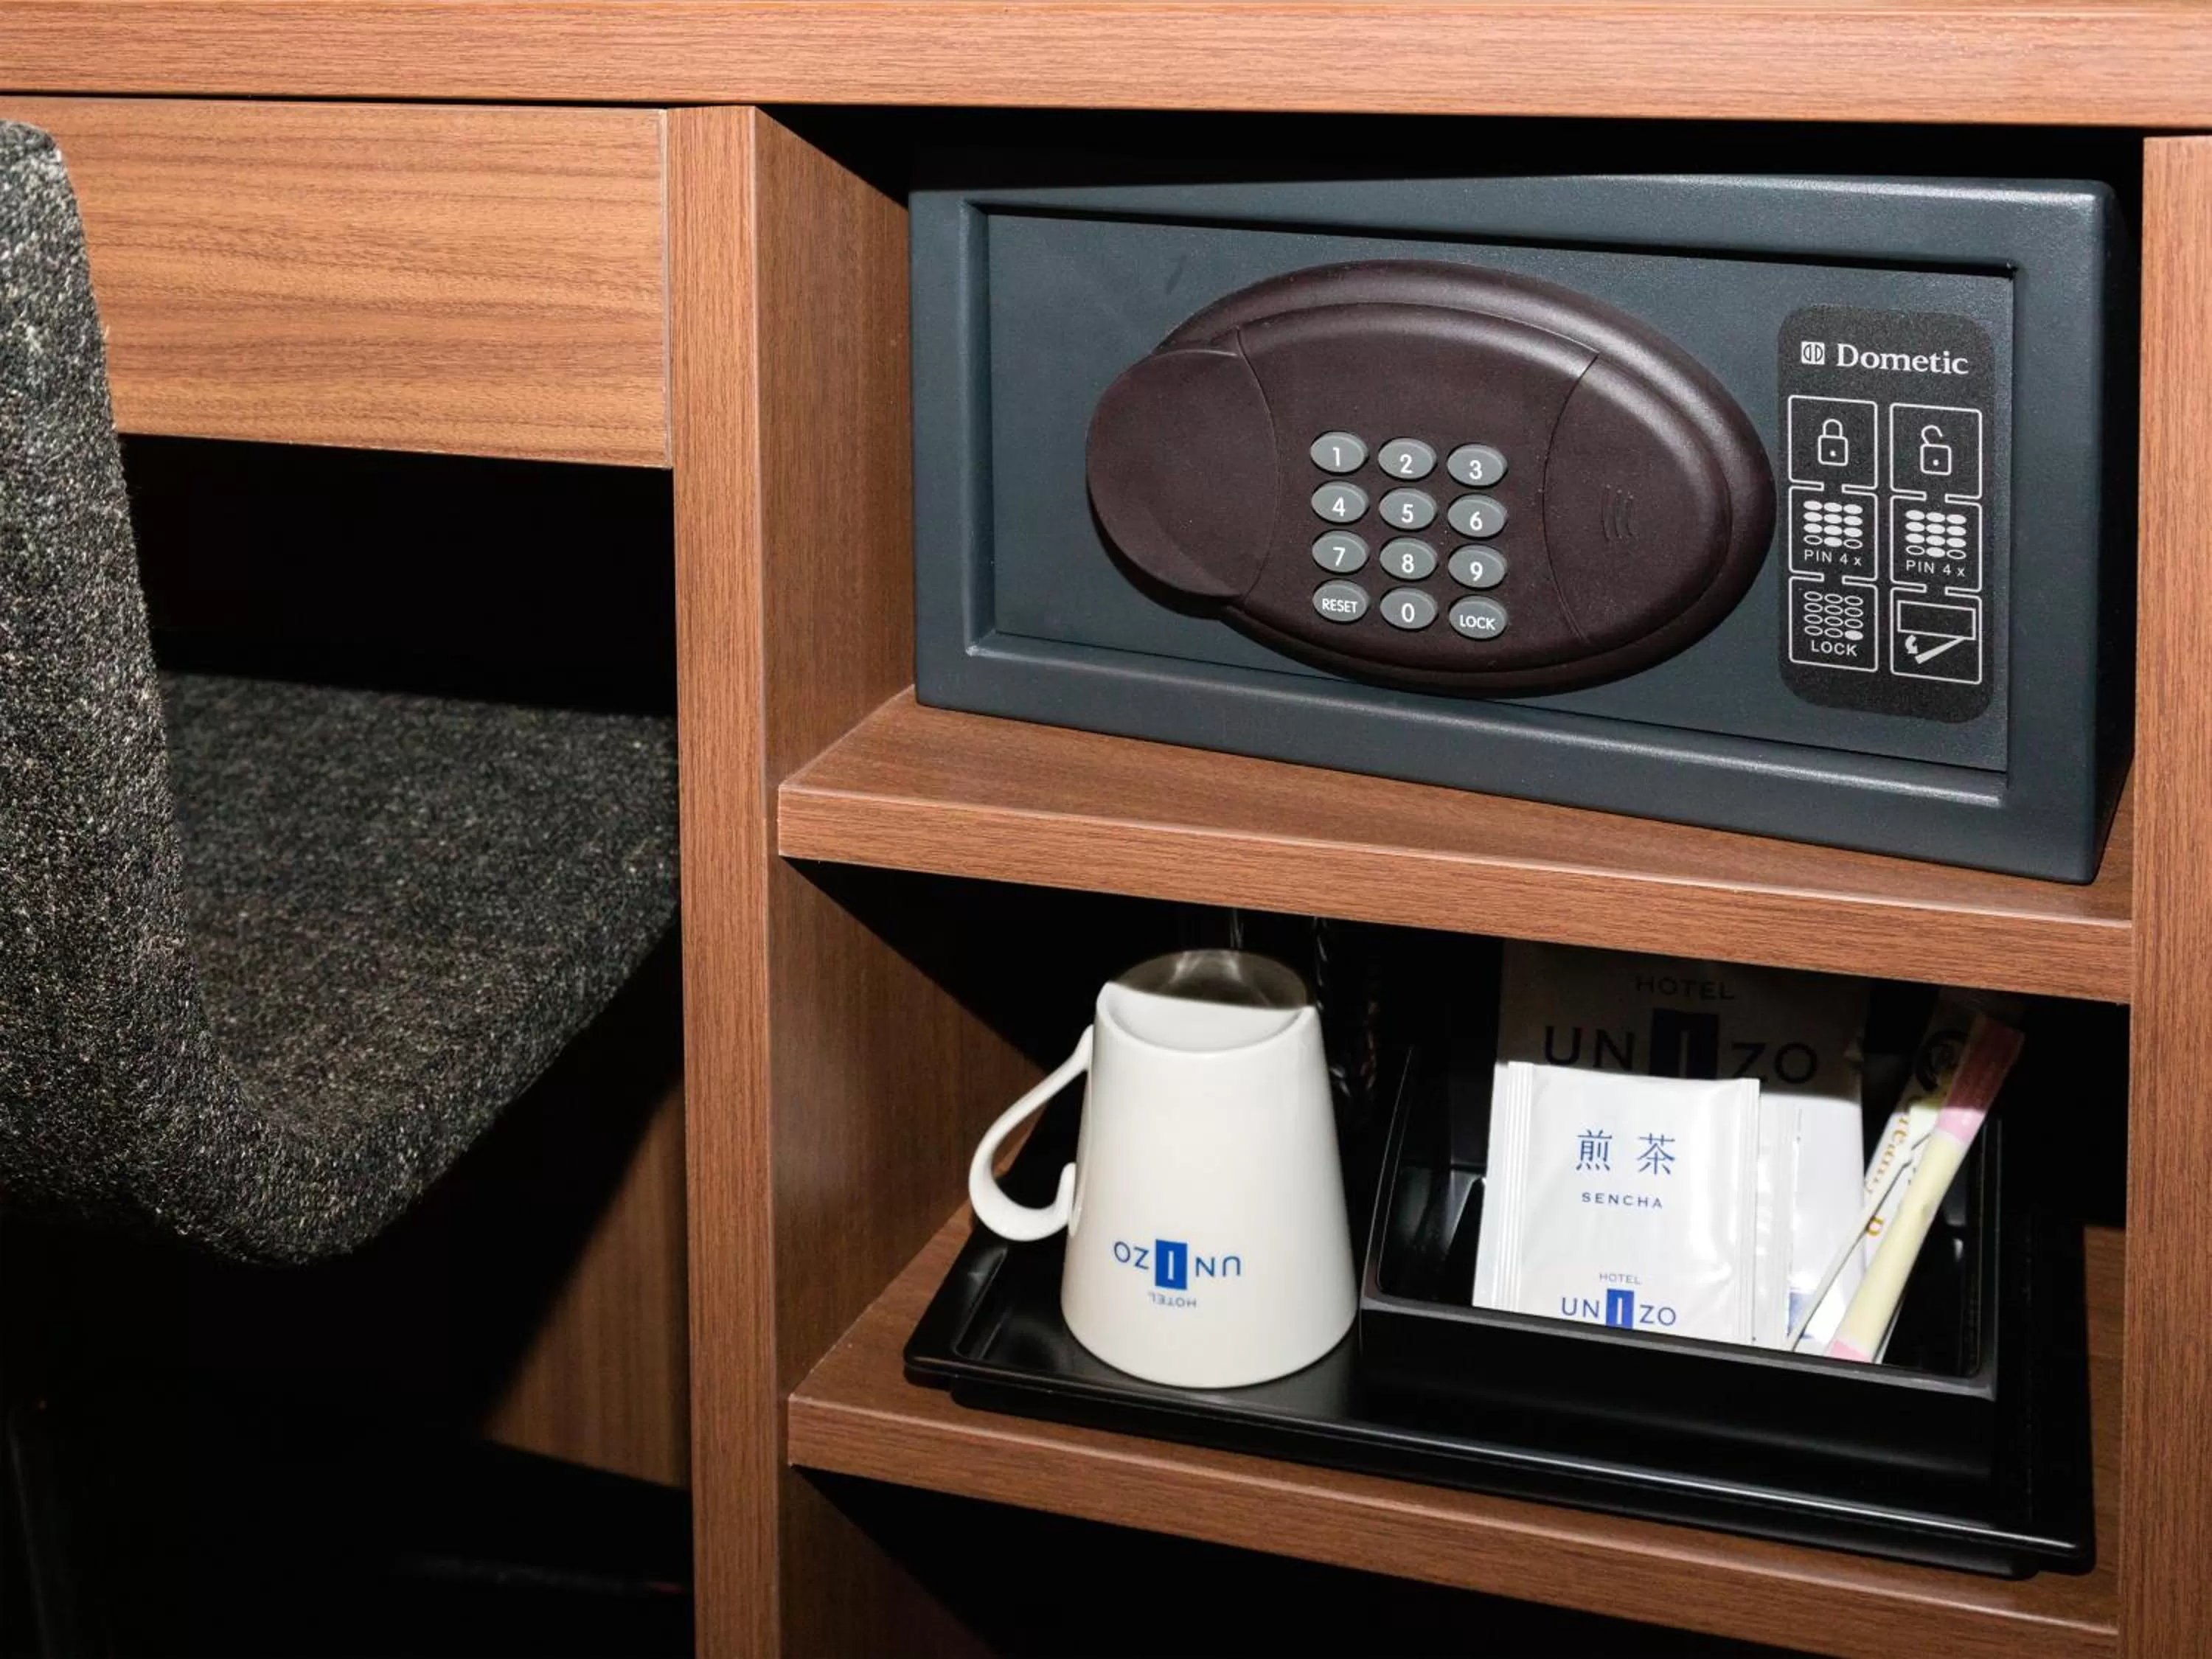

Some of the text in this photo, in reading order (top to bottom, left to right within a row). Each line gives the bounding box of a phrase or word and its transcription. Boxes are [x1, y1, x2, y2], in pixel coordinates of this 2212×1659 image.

[1836, 343, 1969, 375] Dometic
[1332, 447, 1483, 480] 1 2 3
[1332, 496, 1483, 531] 4 5 6
[1332, 546, 1483, 581] 7 8 9
[1804, 549, 1832, 563] PIN
[1906, 560, 1935, 574] PIN
[1321, 598, 1358, 613] RESET
[1401, 602, 1414, 622] 0
[1458, 613, 1496, 630] LOCK
[1811, 640, 1858, 657] LOCK
[1635, 975, 1736, 1001] HOTEL
[1544, 1021, 1818, 1085] UNIZO
[1575, 1129, 1676, 1175] 煎茶
[1581, 1192, 1663, 1210] SENCHA
[1113, 1240, 1242, 1281] UNIZO
[1599, 1271, 1641, 1285] HOTEL
[1148, 1293, 1197, 1308] HOTEL
[1560, 1293, 1677, 1328] UNIZO
